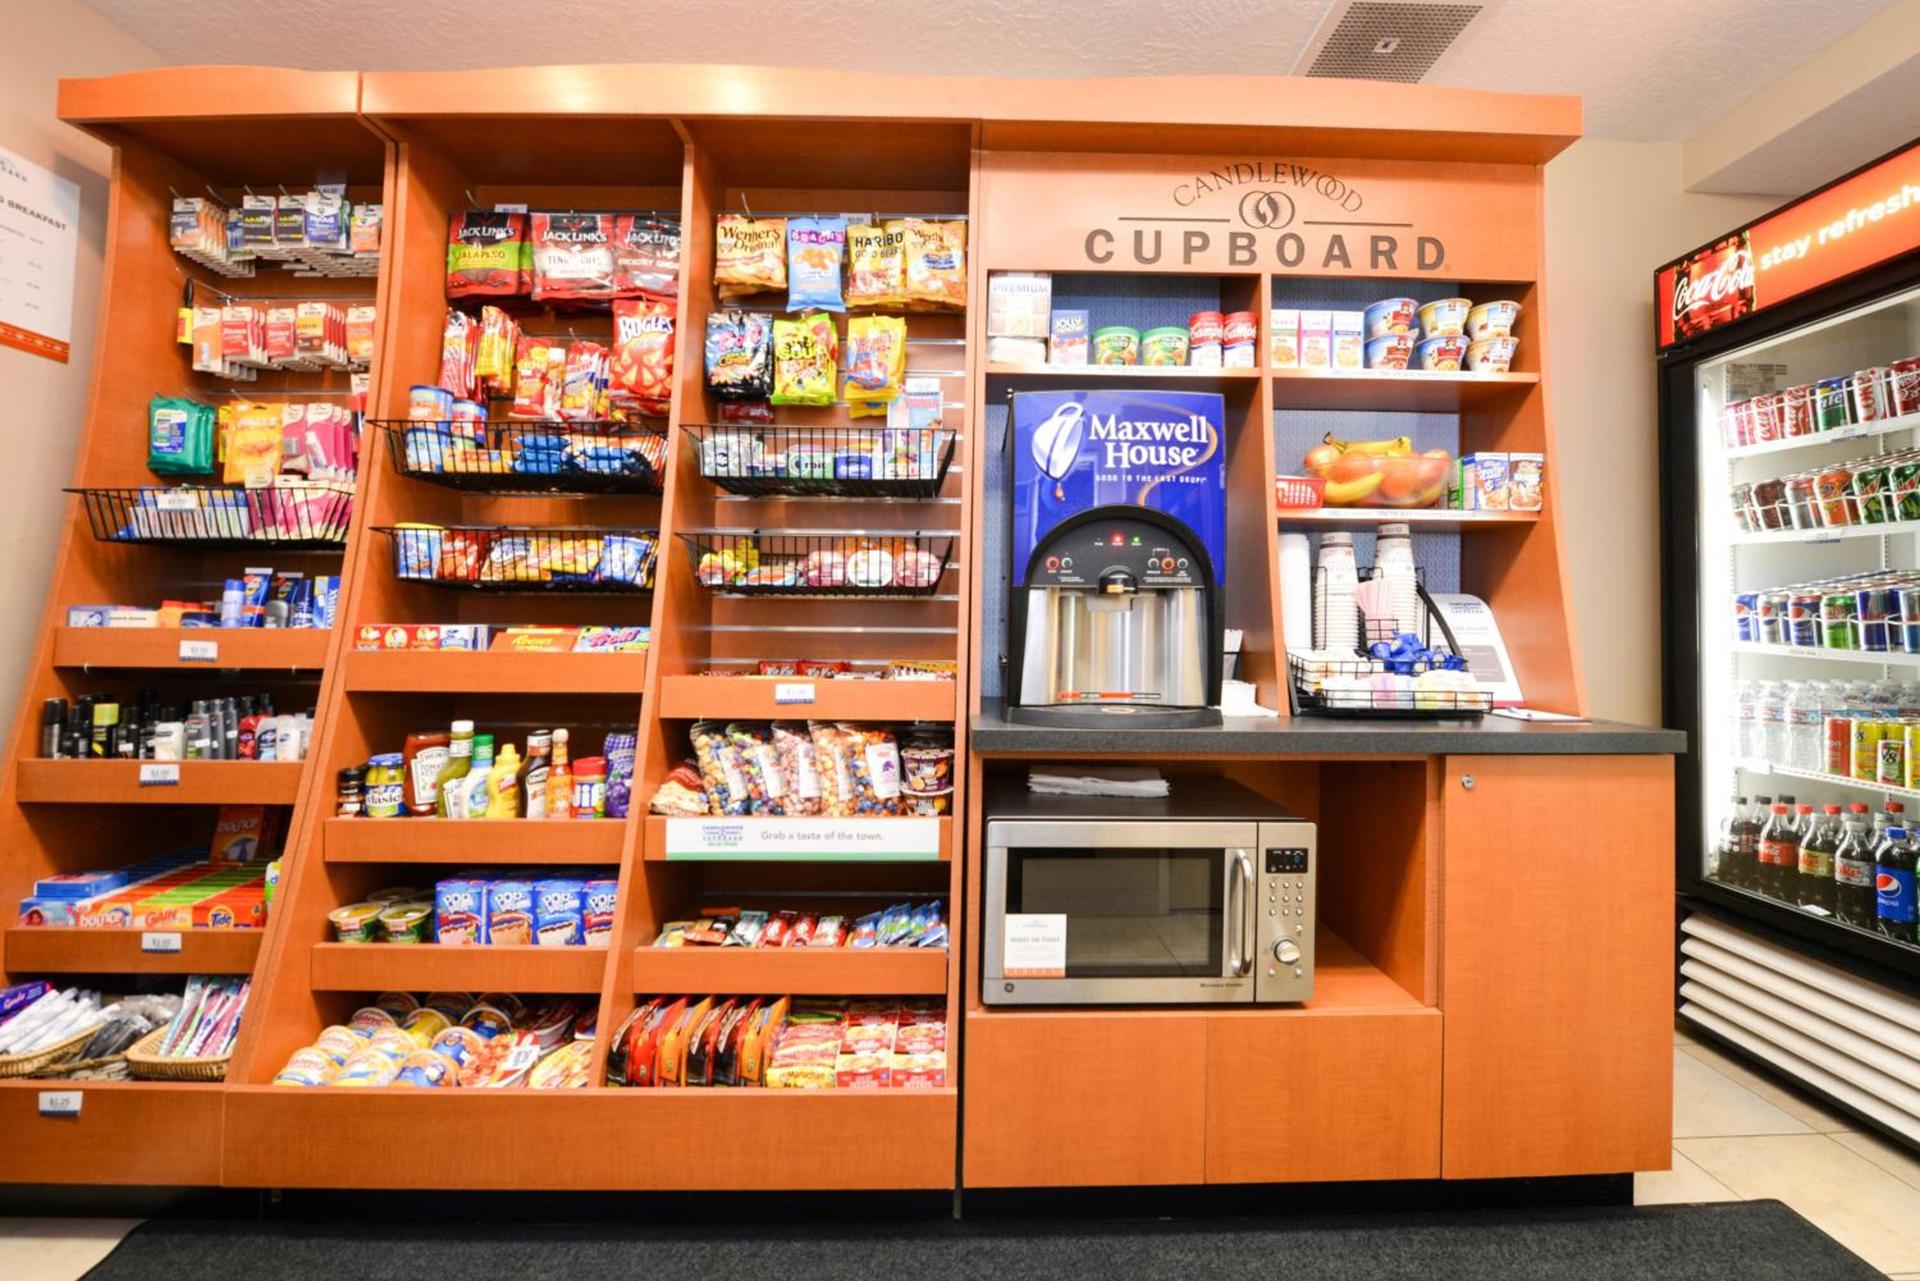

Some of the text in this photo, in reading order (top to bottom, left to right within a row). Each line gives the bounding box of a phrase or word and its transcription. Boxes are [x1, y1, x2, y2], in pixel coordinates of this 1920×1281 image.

[1173, 161, 1364, 214] CANDLEWOOD
[7, 198, 67, 232] BREAKFAST
[457, 226, 481, 241] JACK
[542, 230, 572, 243] JACK
[855, 232, 904, 249] HARIBO
[1084, 228, 1446, 272] CUPBOARD
[1760, 233, 1812, 271] stay
[993, 282, 1048, 294] PREMIUM
[1088, 414, 1209, 443] Maxwell
[1104, 442, 1198, 468] House
[1095, 474, 1119, 482] GOOD
[1122, 474, 1133, 482] TO
[1136, 474, 1152, 483] THE
[1155, 474, 1177, 483] LAST
[761, 831, 786, 841] Grab
[797, 831, 819, 841] taste
[824, 831, 835, 841] of
[837, 831, 853, 841] the
[211, 911, 232, 928] Tide
